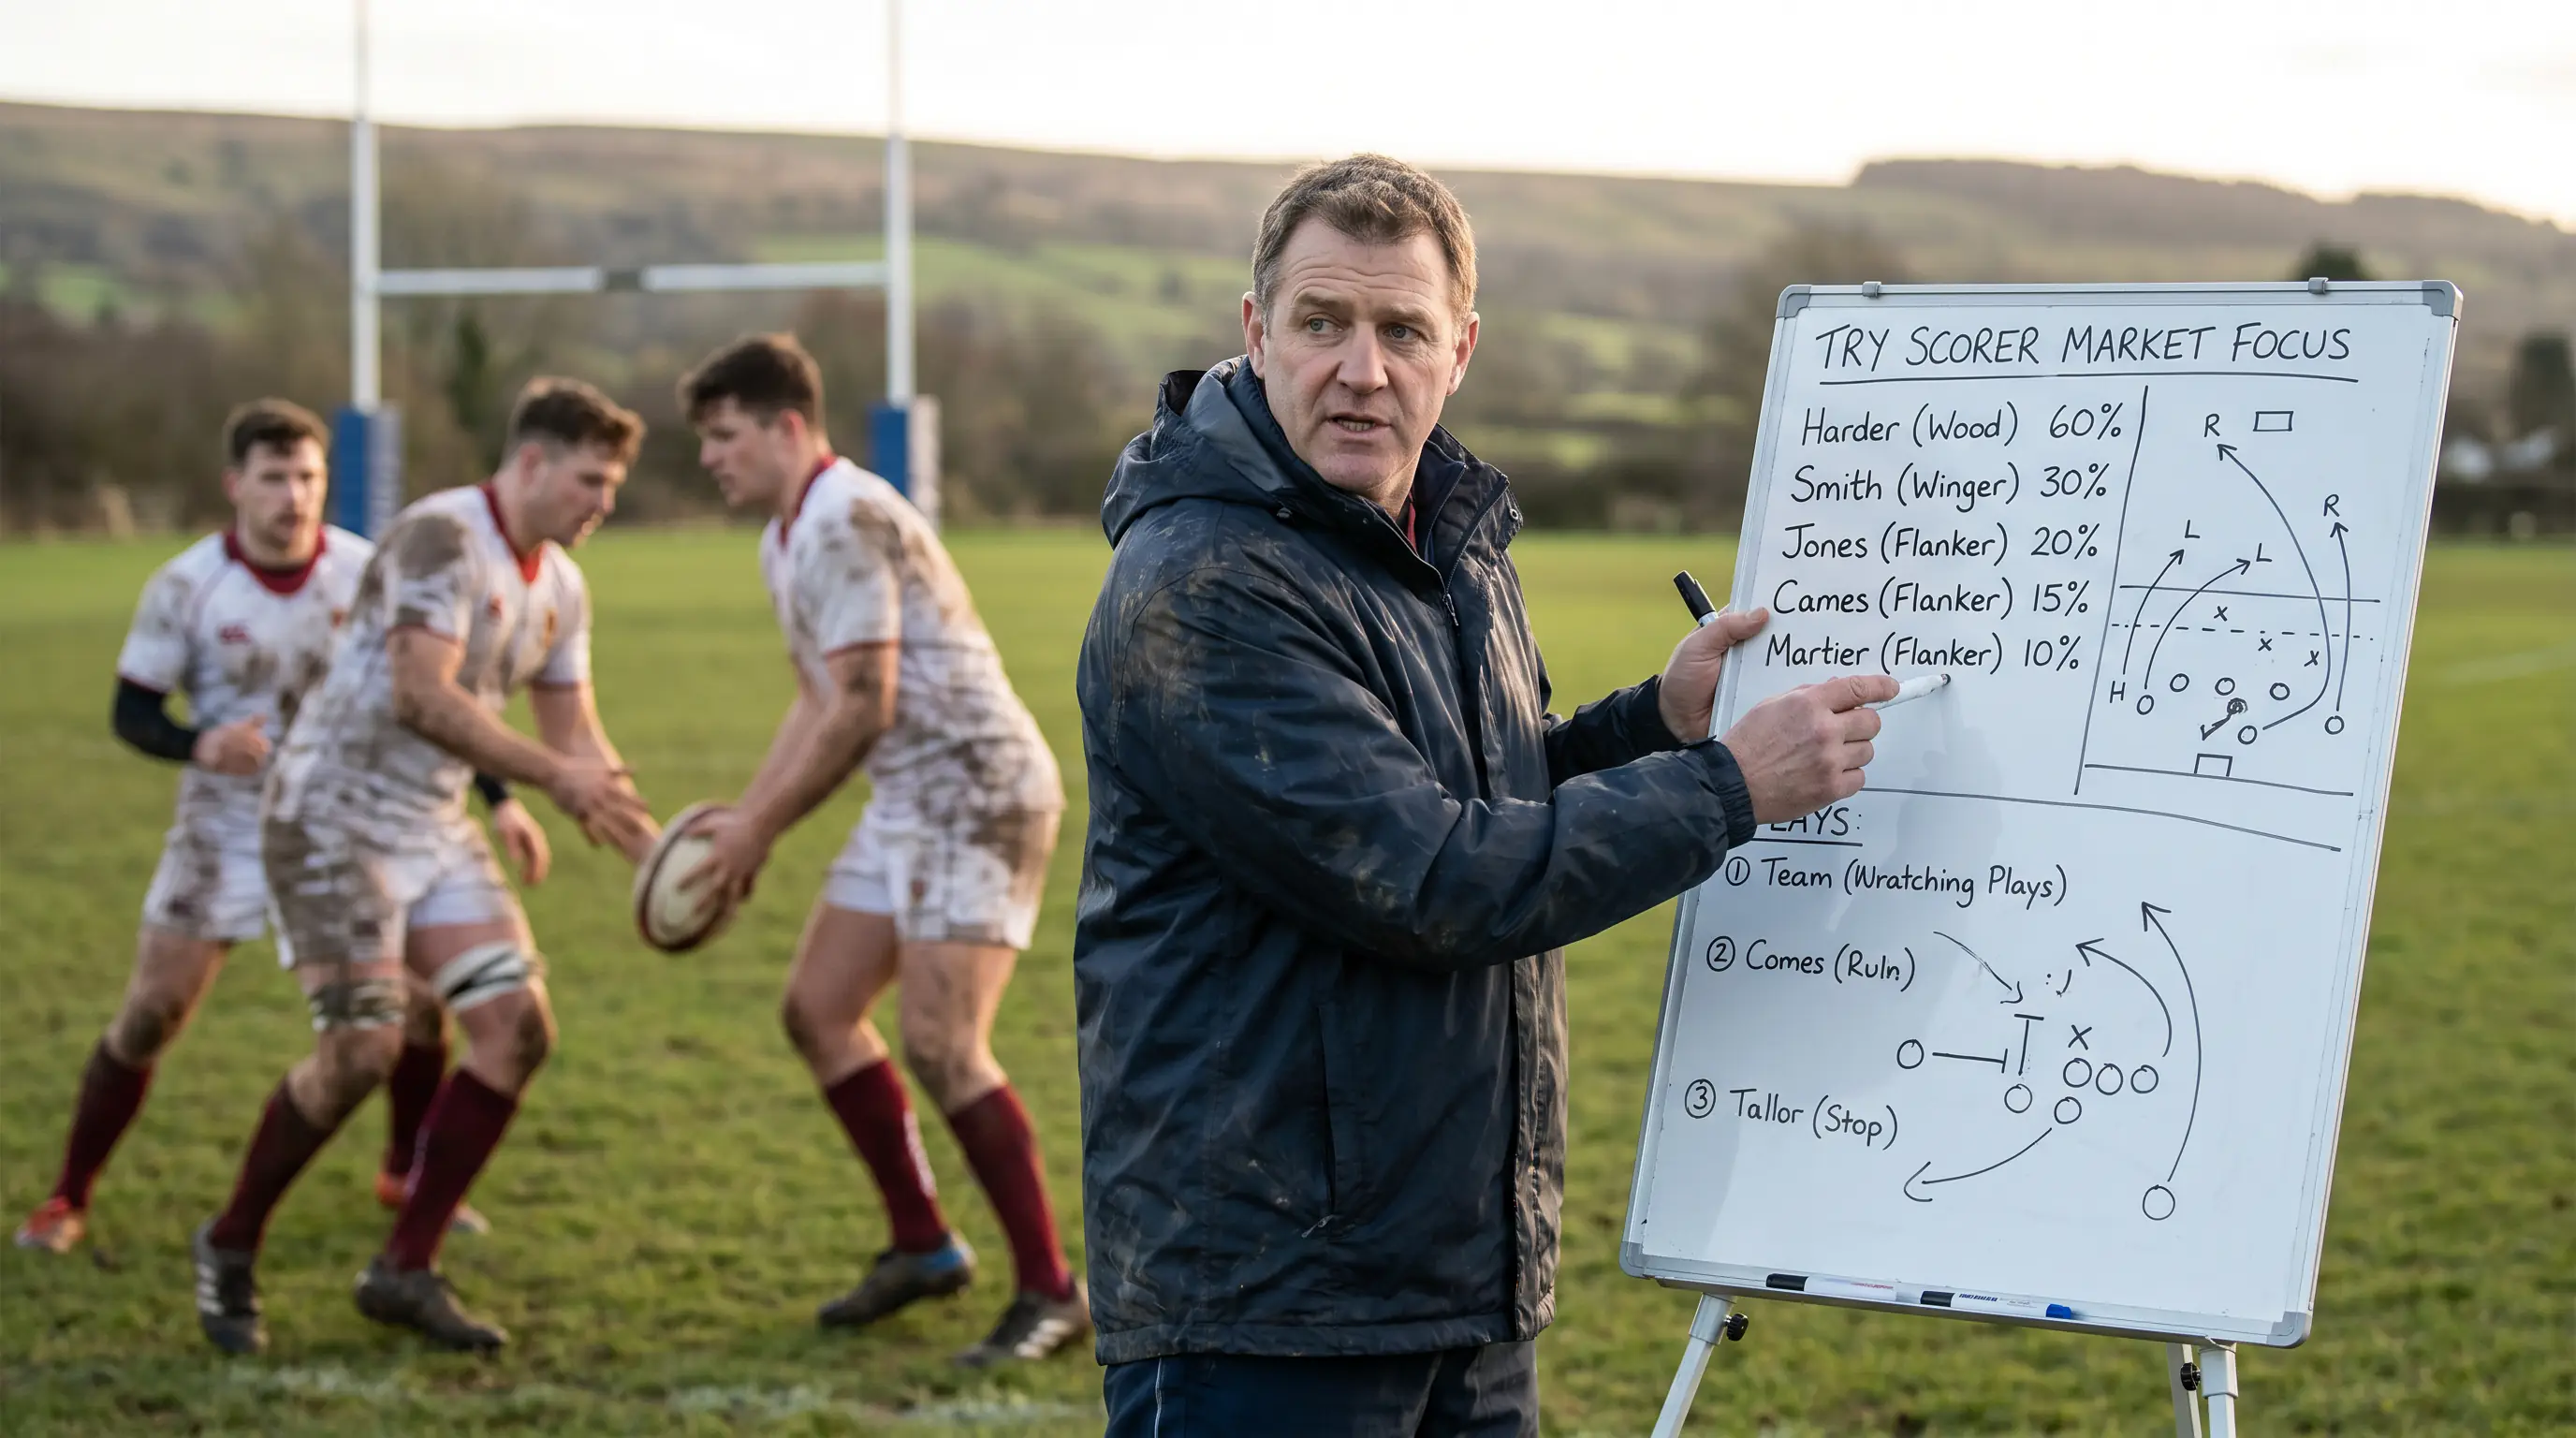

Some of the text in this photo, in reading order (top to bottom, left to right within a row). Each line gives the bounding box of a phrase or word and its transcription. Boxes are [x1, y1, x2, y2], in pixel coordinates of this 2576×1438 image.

[1815, 321, 2351, 372] TRY SCORER MARKET FOCUS
[1801, 402, 2124, 448] Harder (Wood) 60%
[1790, 462, 2110, 514] Smith (Winger) 30%
[1781, 521, 2100, 565] Jones (Flanker) 20%
[1773, 575, 2090, 622] Cames (Flanker) 15%
[1764, 631, 2082, 676] Martier (Flanker) 10%
[1760, 857, 1833, 889] Team
[1843, 858, 1975, 909] (Wratching
[1987, 863, 2067, 911] Plays)
[1746, 938, 1825, 975] Comes
[1812, 1094, 1899, 1151] (Stop)
